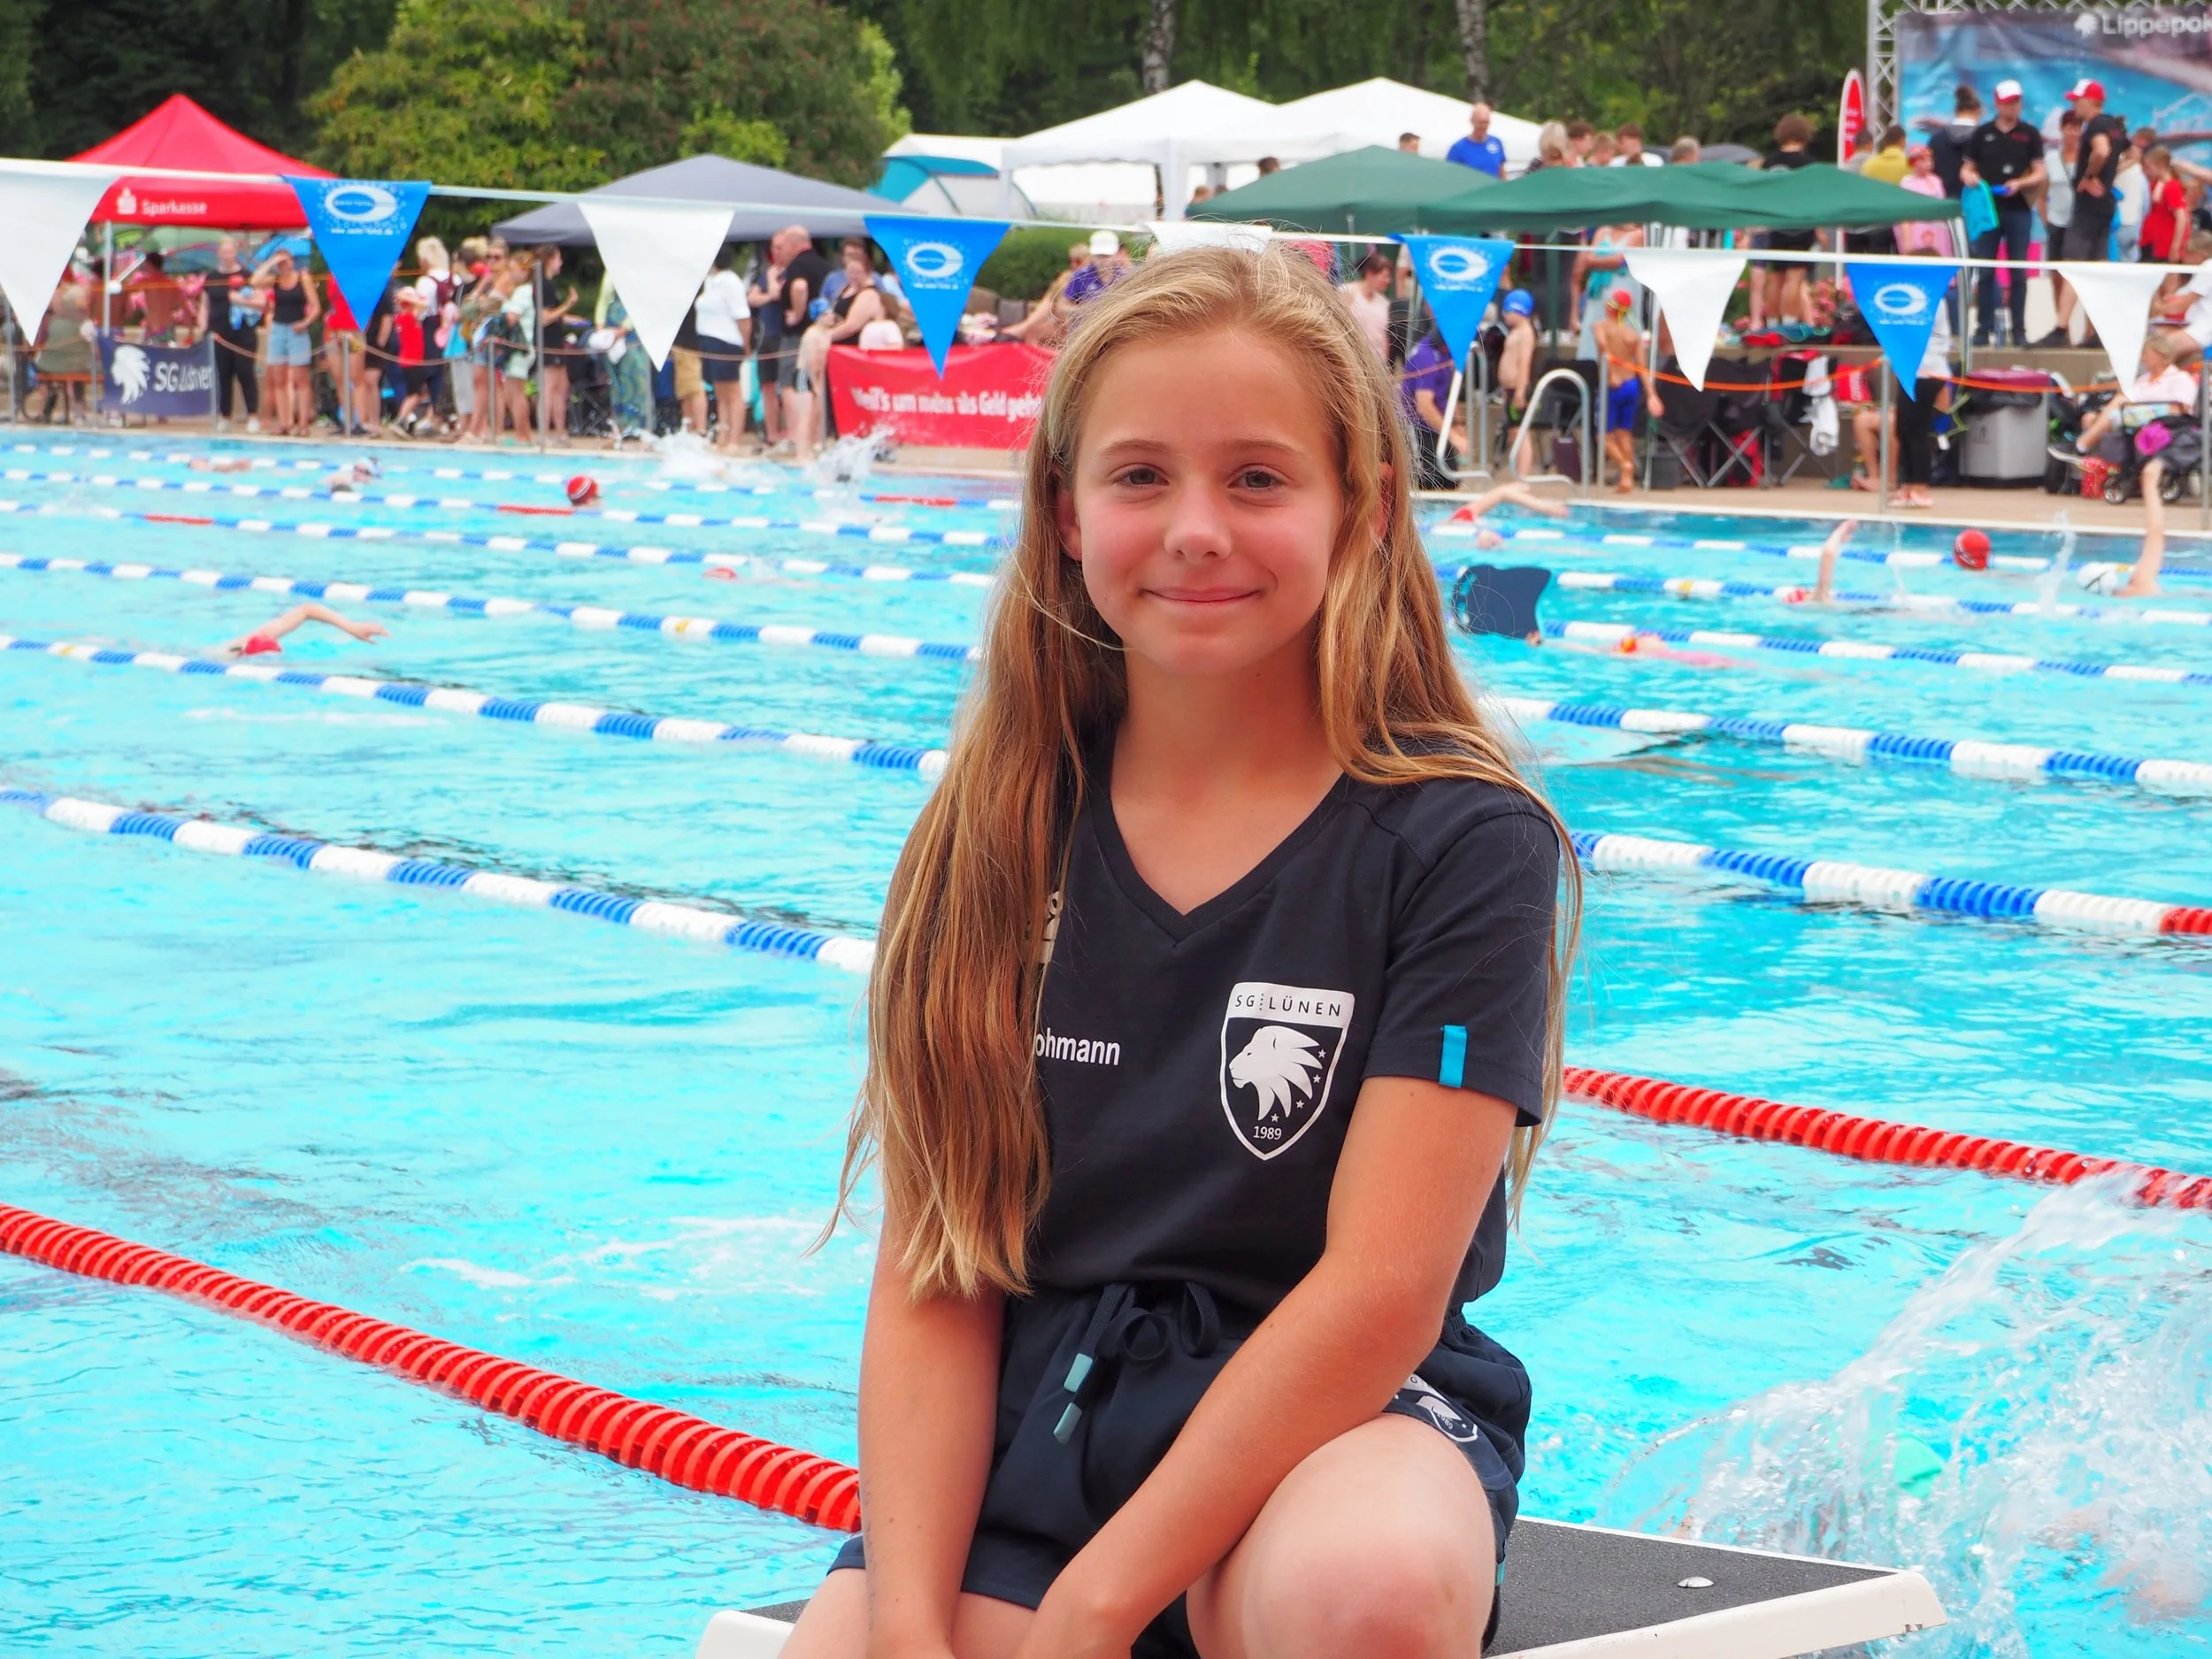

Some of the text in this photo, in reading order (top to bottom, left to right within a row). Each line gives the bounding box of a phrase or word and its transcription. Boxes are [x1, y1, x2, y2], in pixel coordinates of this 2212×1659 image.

[142, 198, 207, 217] Sparkasse
[153, 361, 179, 392] SG
[1235, 995, 1341, 1017] SG LÜNEN
[1035, 1027, 1121, 1066] ohmann
[1253, 1125, 1282, 1141] 1989
